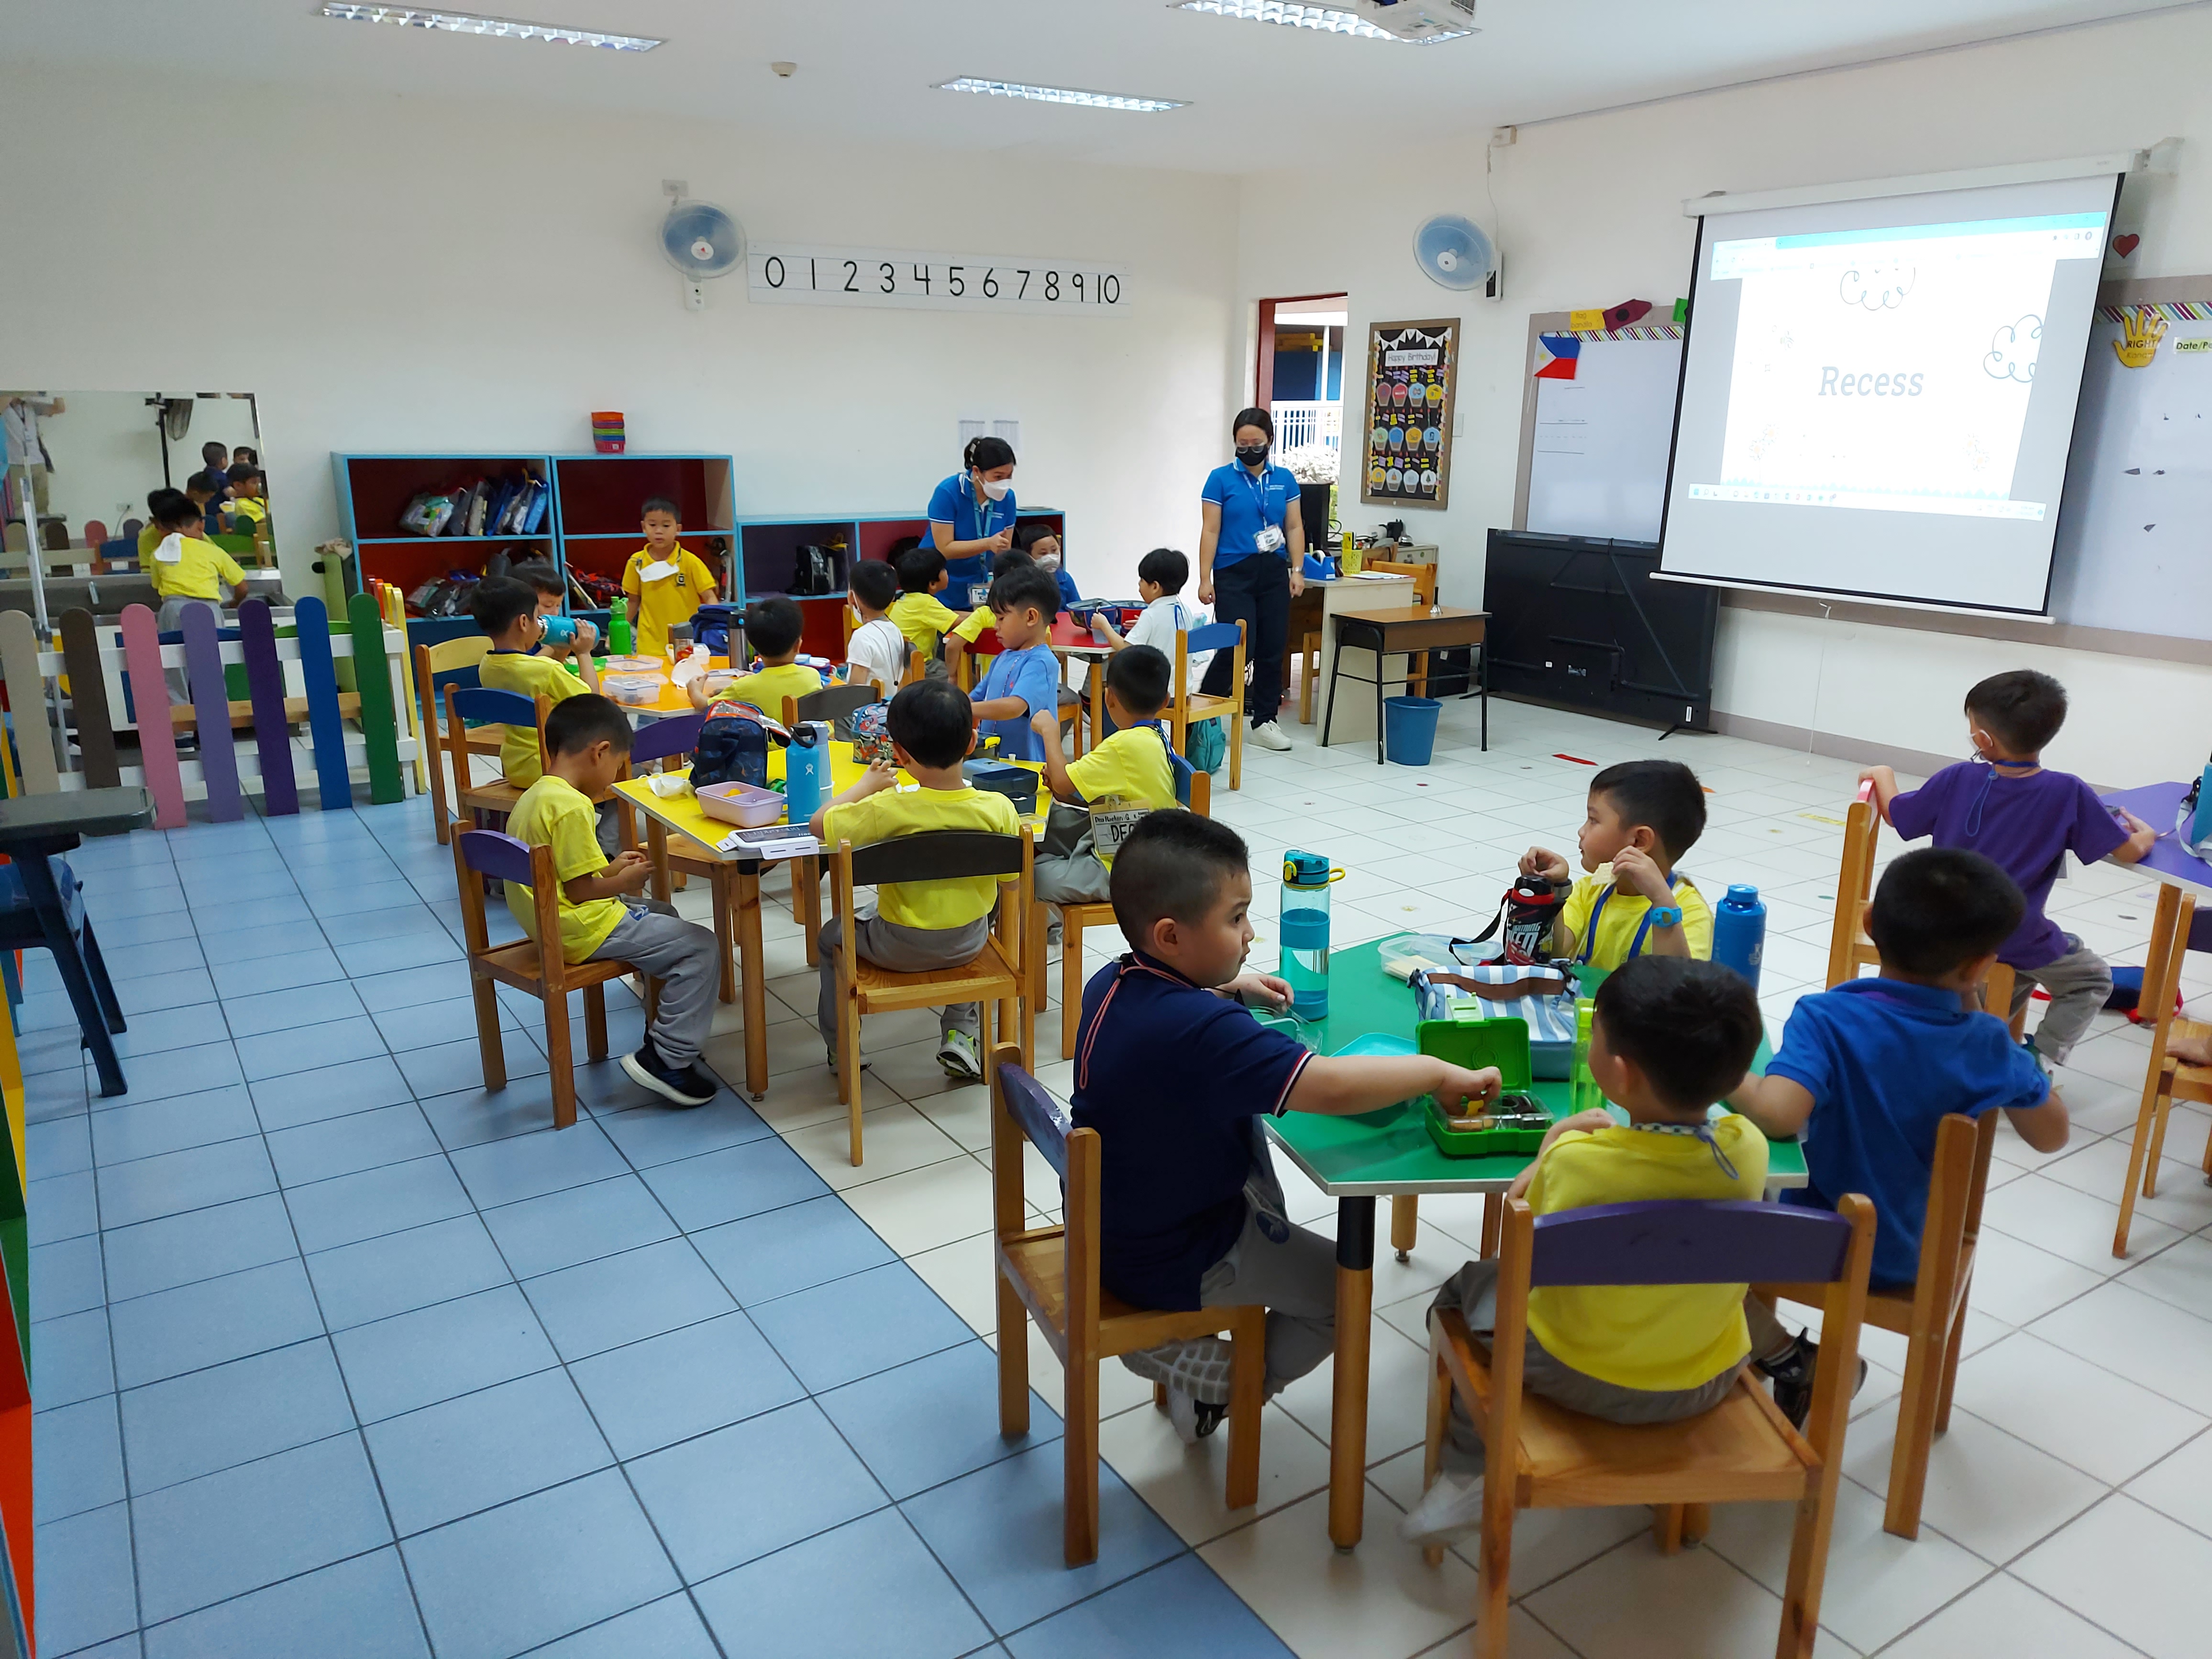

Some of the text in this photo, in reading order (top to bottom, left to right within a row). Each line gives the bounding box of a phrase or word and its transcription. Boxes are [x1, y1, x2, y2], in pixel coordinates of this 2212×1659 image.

[765, 256, 1120, 304] 0 1 2 3 4 5 6 7 8 9 10
[2127, 340, 2157, 348] RIGHT
[1388, 354, 1405, 363] Happy
[1818, 366, 1924, 396] Recess
